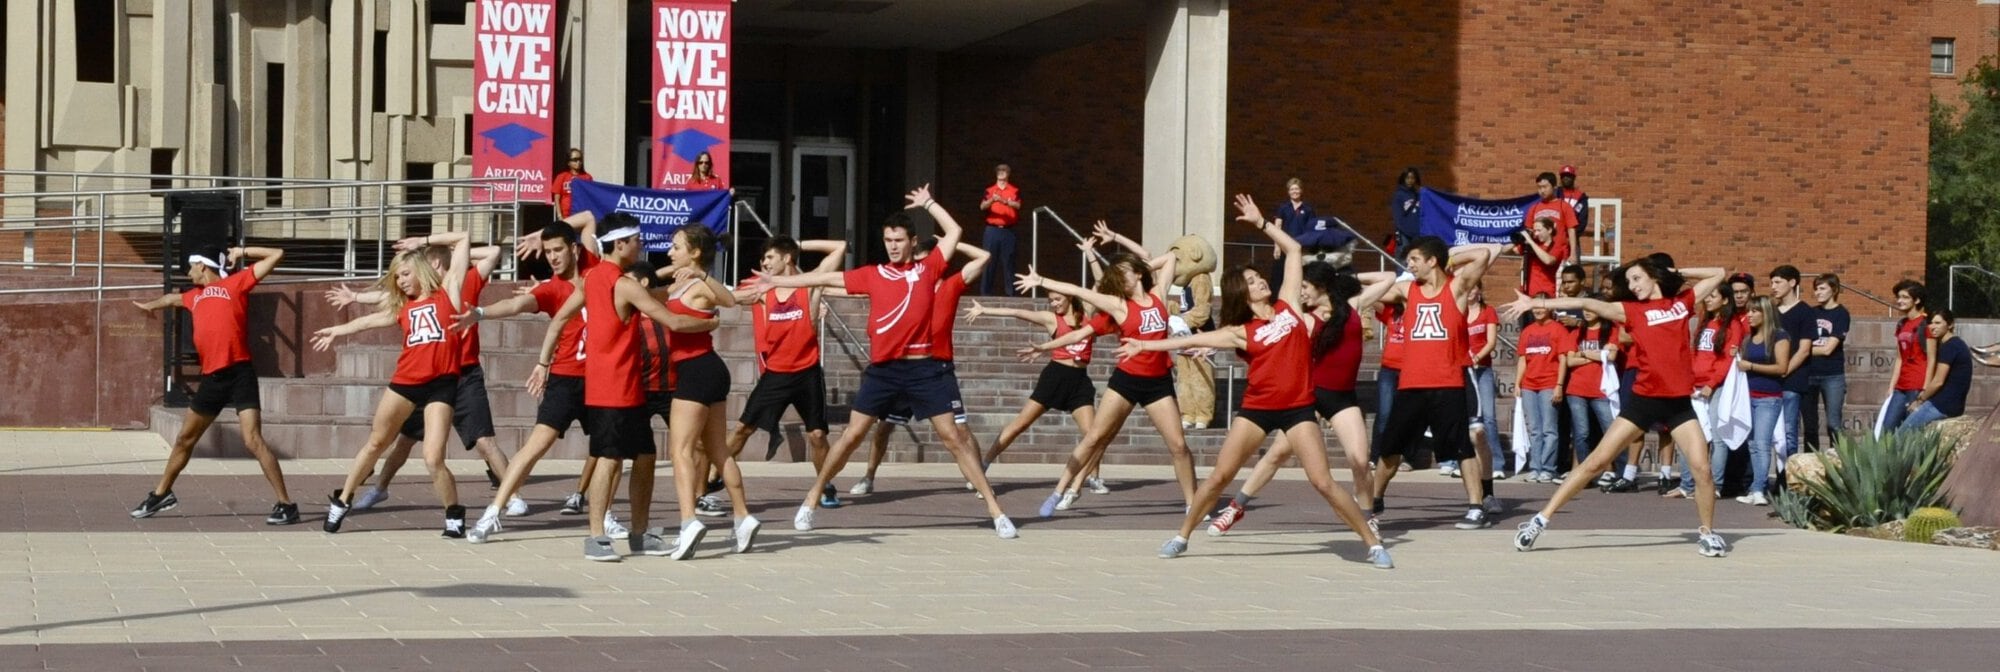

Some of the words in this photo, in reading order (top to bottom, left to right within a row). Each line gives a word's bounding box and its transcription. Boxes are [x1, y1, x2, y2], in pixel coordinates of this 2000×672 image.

[481, 0, 551, 33] NOW
[658, 8, 726, 40] NOW
[478, 34, 550, 80] WE
[656, 41, 726, 86] WE
[478, 81, 550, 118] CAN!
[656, 88, 726, 124] CAN!
[663, 171, 692, 185] ARIZ
[1460, 218, 1523, 228] assurance
[407, 303, 446, 347] A
[1139, 307, 1166, 335] A
[1411, 303, 1448, 341] A
[1698, 328, 1716, 351] A
